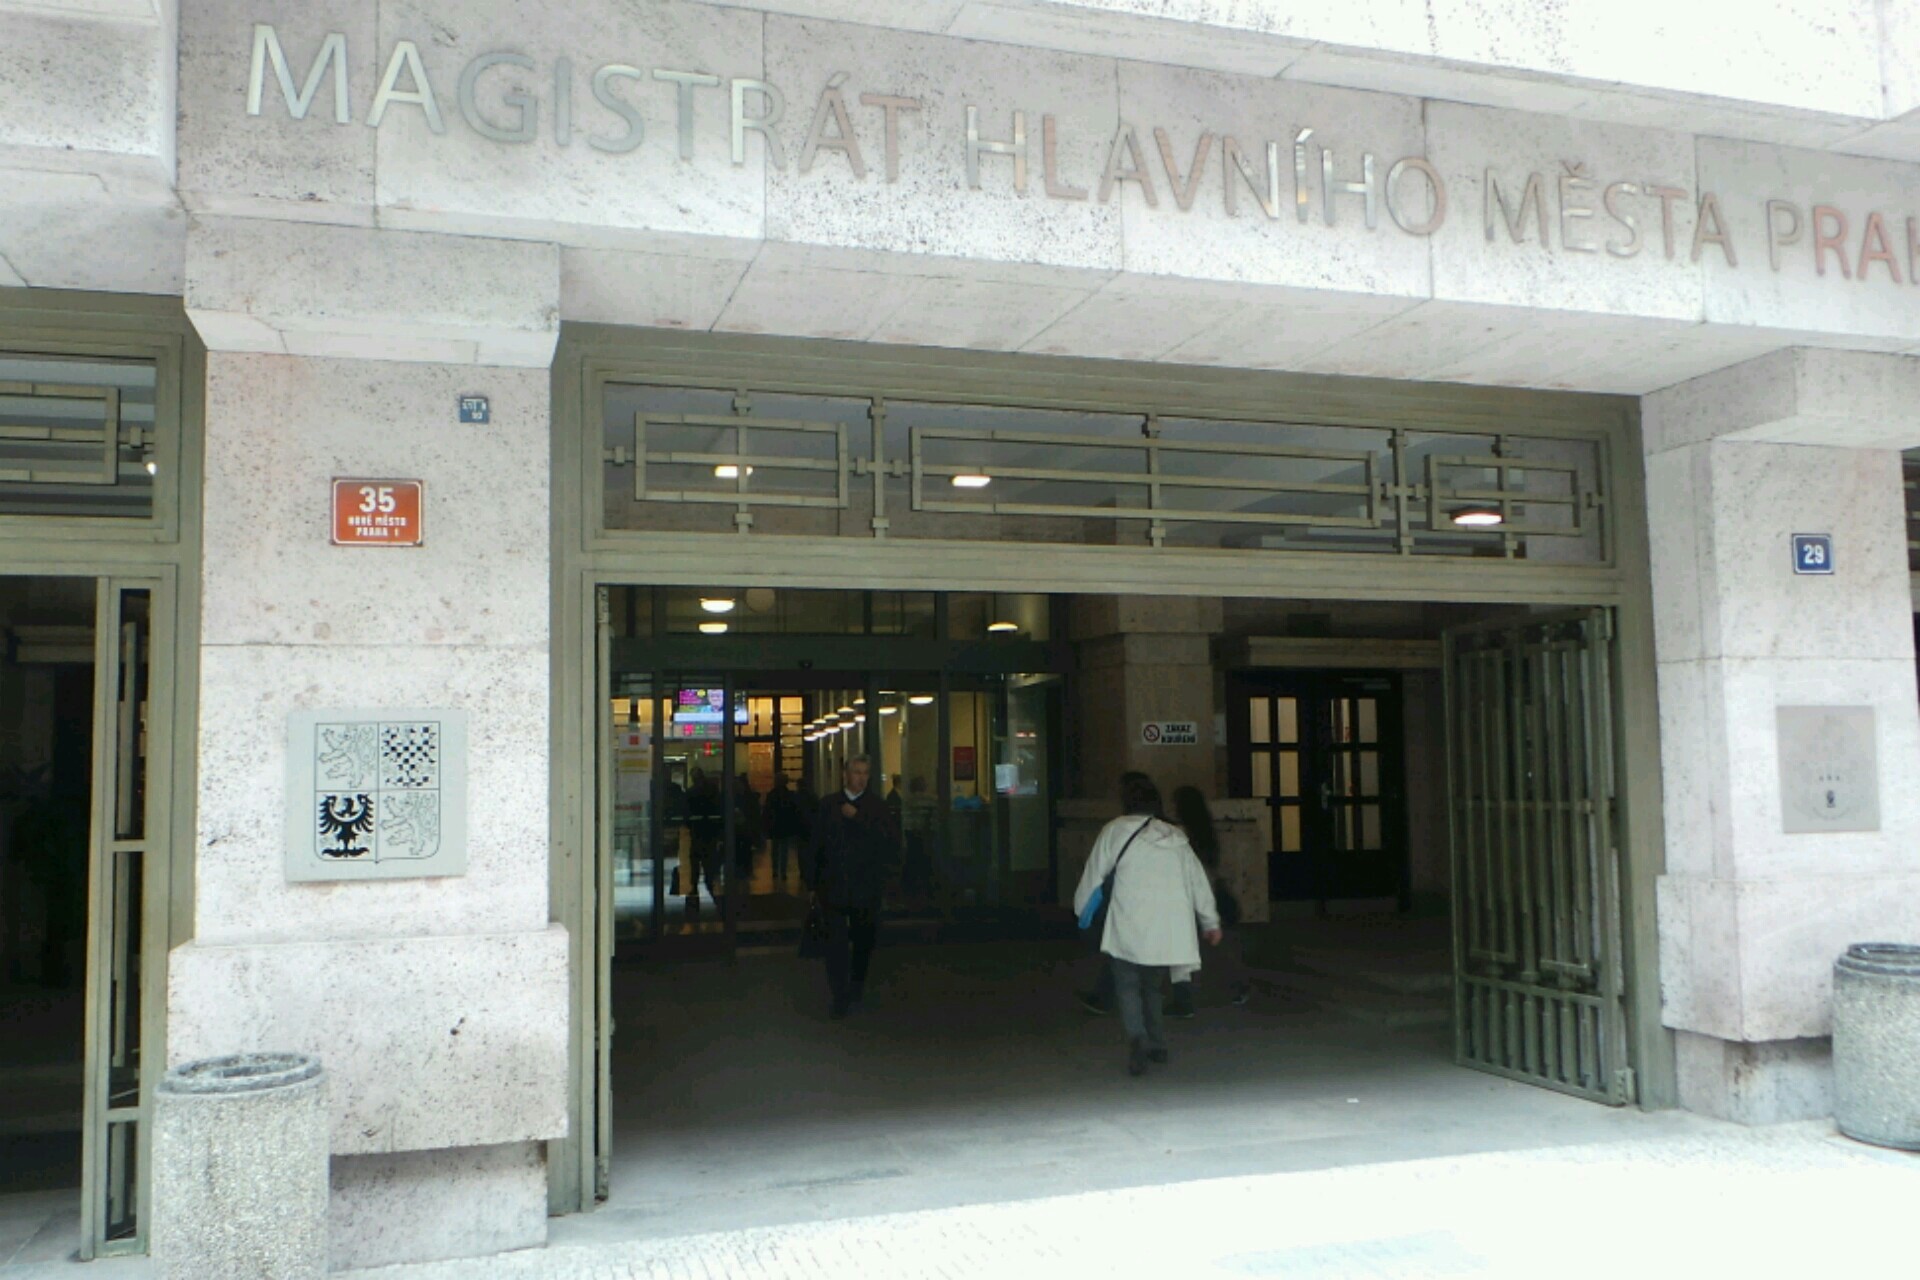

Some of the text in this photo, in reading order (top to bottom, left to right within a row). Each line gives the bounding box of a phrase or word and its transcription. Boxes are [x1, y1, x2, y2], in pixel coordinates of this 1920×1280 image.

[246, 23, 926, 184] MAGISTRÁT
[963, 104, 1447, 237] HLAVNÍHO
[1484, 160, 1739, 268] MĚSTA
[359, 486, 396, 513] 35
[356, 527, 388, 537] PRAHA
[1803, 544, 1824, 564] 29
